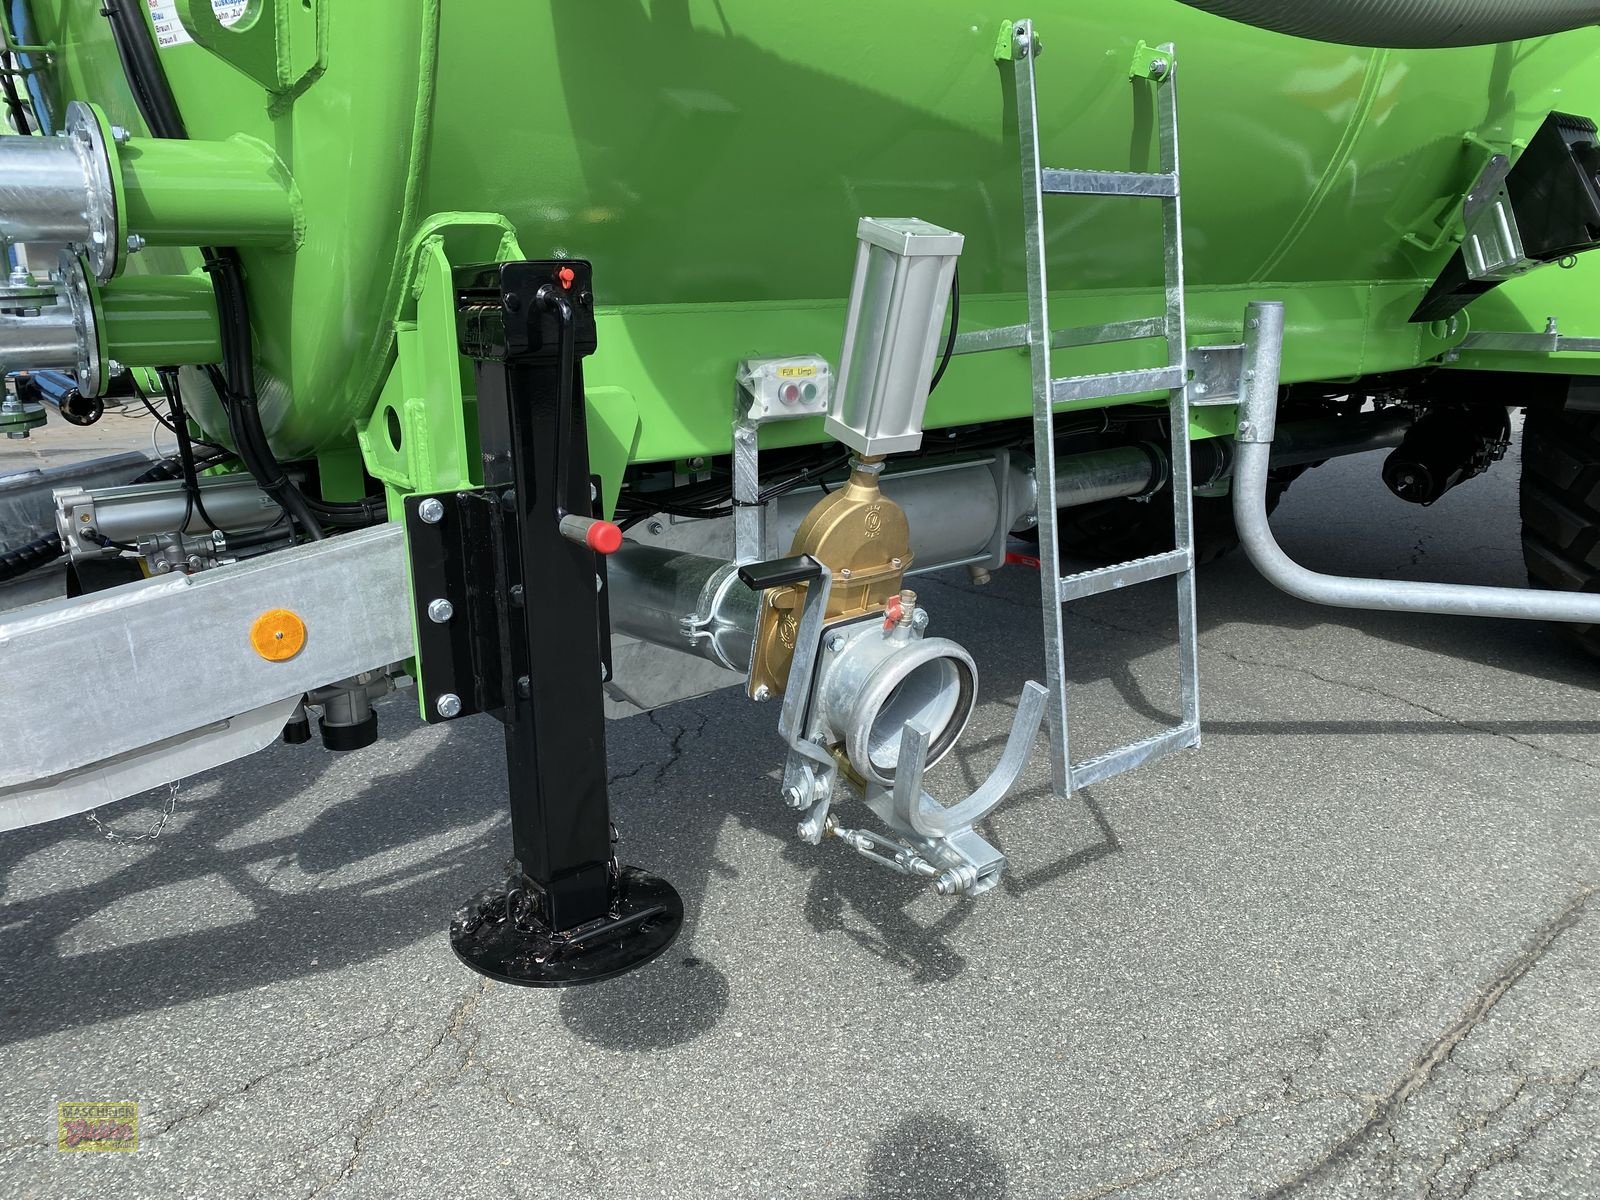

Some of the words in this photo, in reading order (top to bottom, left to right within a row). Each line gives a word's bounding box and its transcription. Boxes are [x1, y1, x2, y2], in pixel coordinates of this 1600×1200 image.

[214, 0, 245, 8] ausklapp
[152, 12, 164, 21] Blau
[155, 24, 170, 33] Braun
[159, 36, 174, 45] Braun
